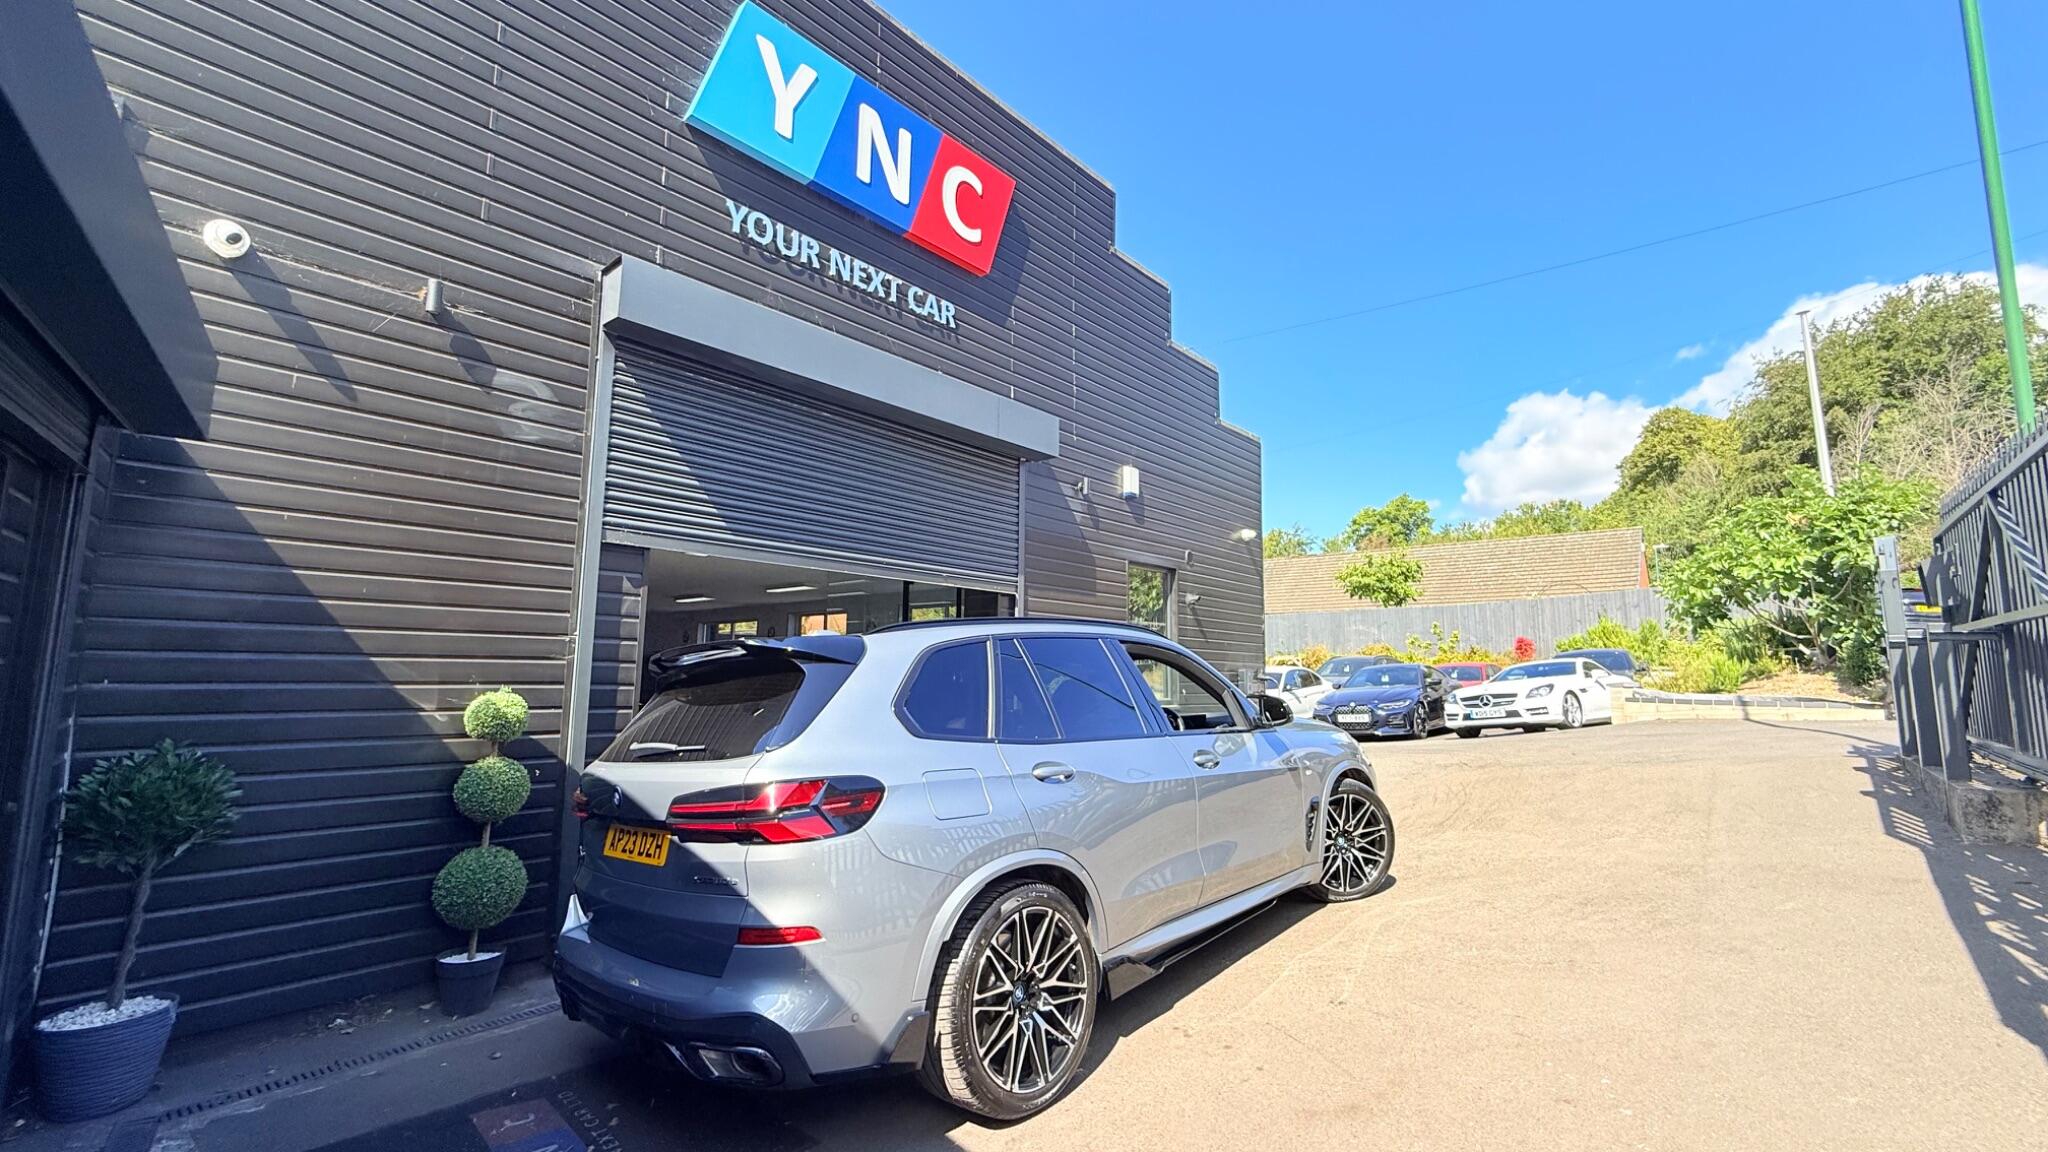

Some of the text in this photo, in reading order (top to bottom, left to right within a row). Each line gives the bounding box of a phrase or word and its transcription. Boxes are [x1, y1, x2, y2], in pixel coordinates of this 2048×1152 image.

[756, 33, 983, 243] YNC
[726, 199, 957, 329] YOUR NEXT CAR
[608, 828, 666, 859] AP23 DZH
[591, 1127, 623, 1152] EXT
